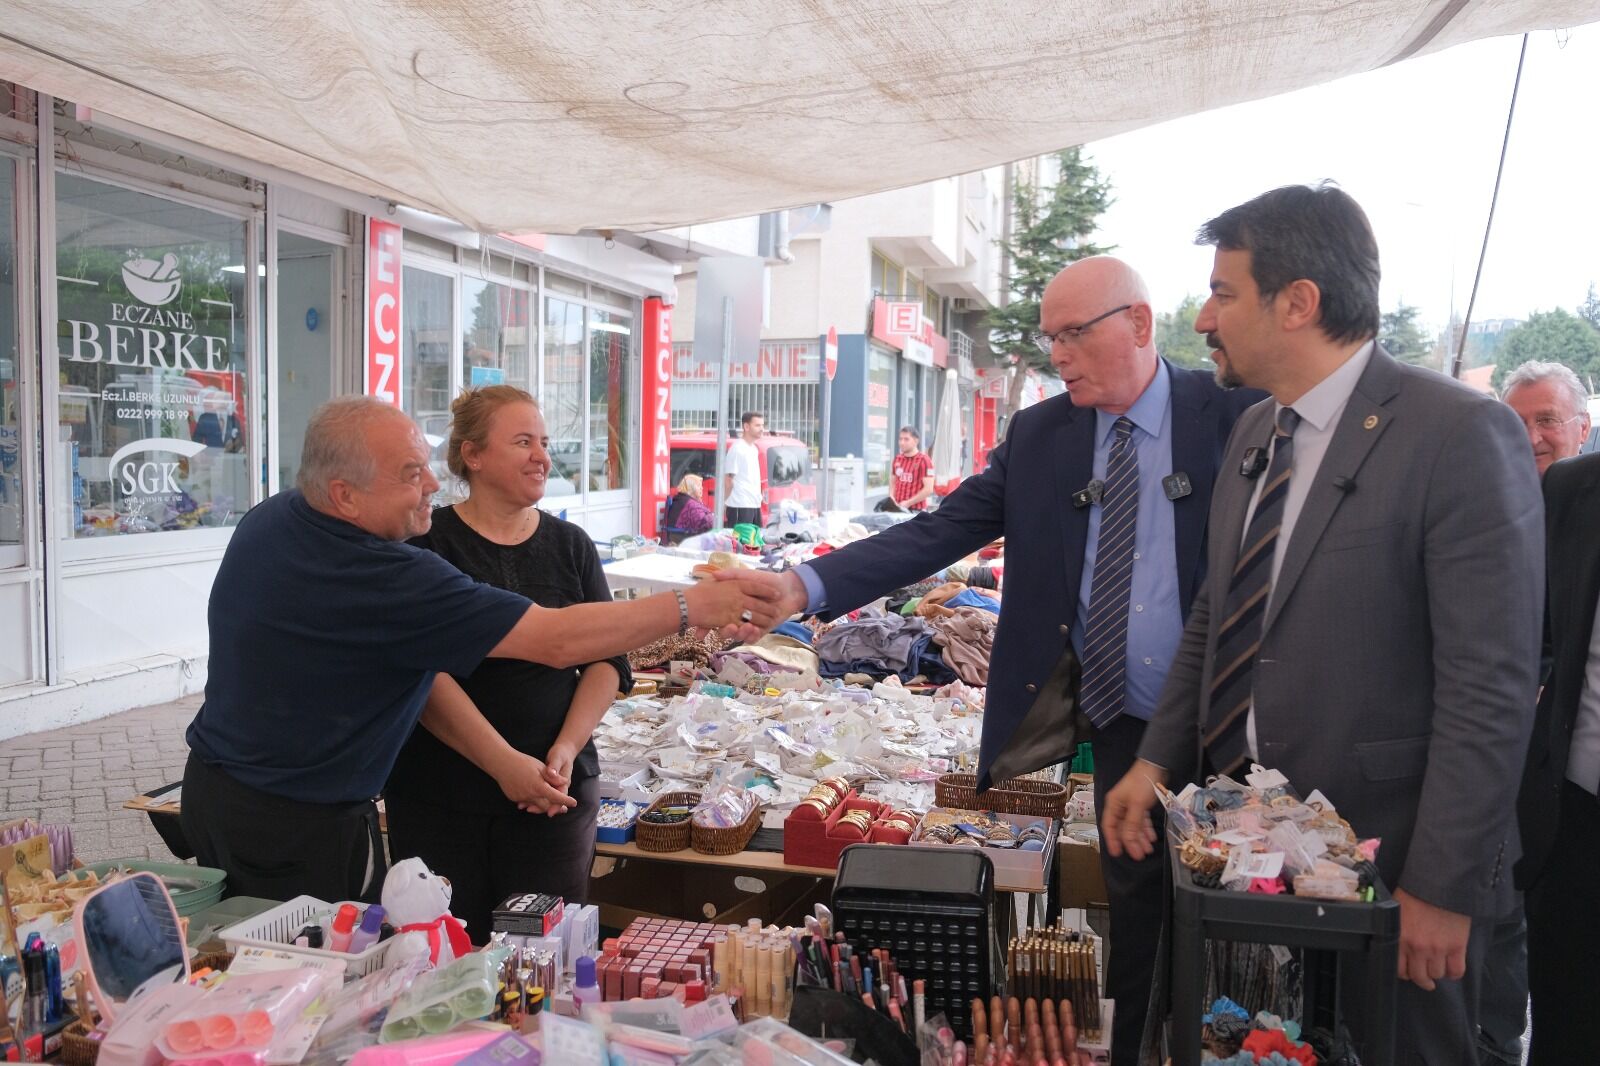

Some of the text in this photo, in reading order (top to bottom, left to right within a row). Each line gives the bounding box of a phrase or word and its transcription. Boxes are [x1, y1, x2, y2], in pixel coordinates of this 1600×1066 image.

[112, 303, 193, 330] ECZANE
[897, 308, 912, 329] E
[67, 319, 230, 373] BERKE
[163, 393, 200, 405] UZUNLU
[116, 408, 189, 420] 0222 999 18 99
[121, 462, 183, 495] SGK
